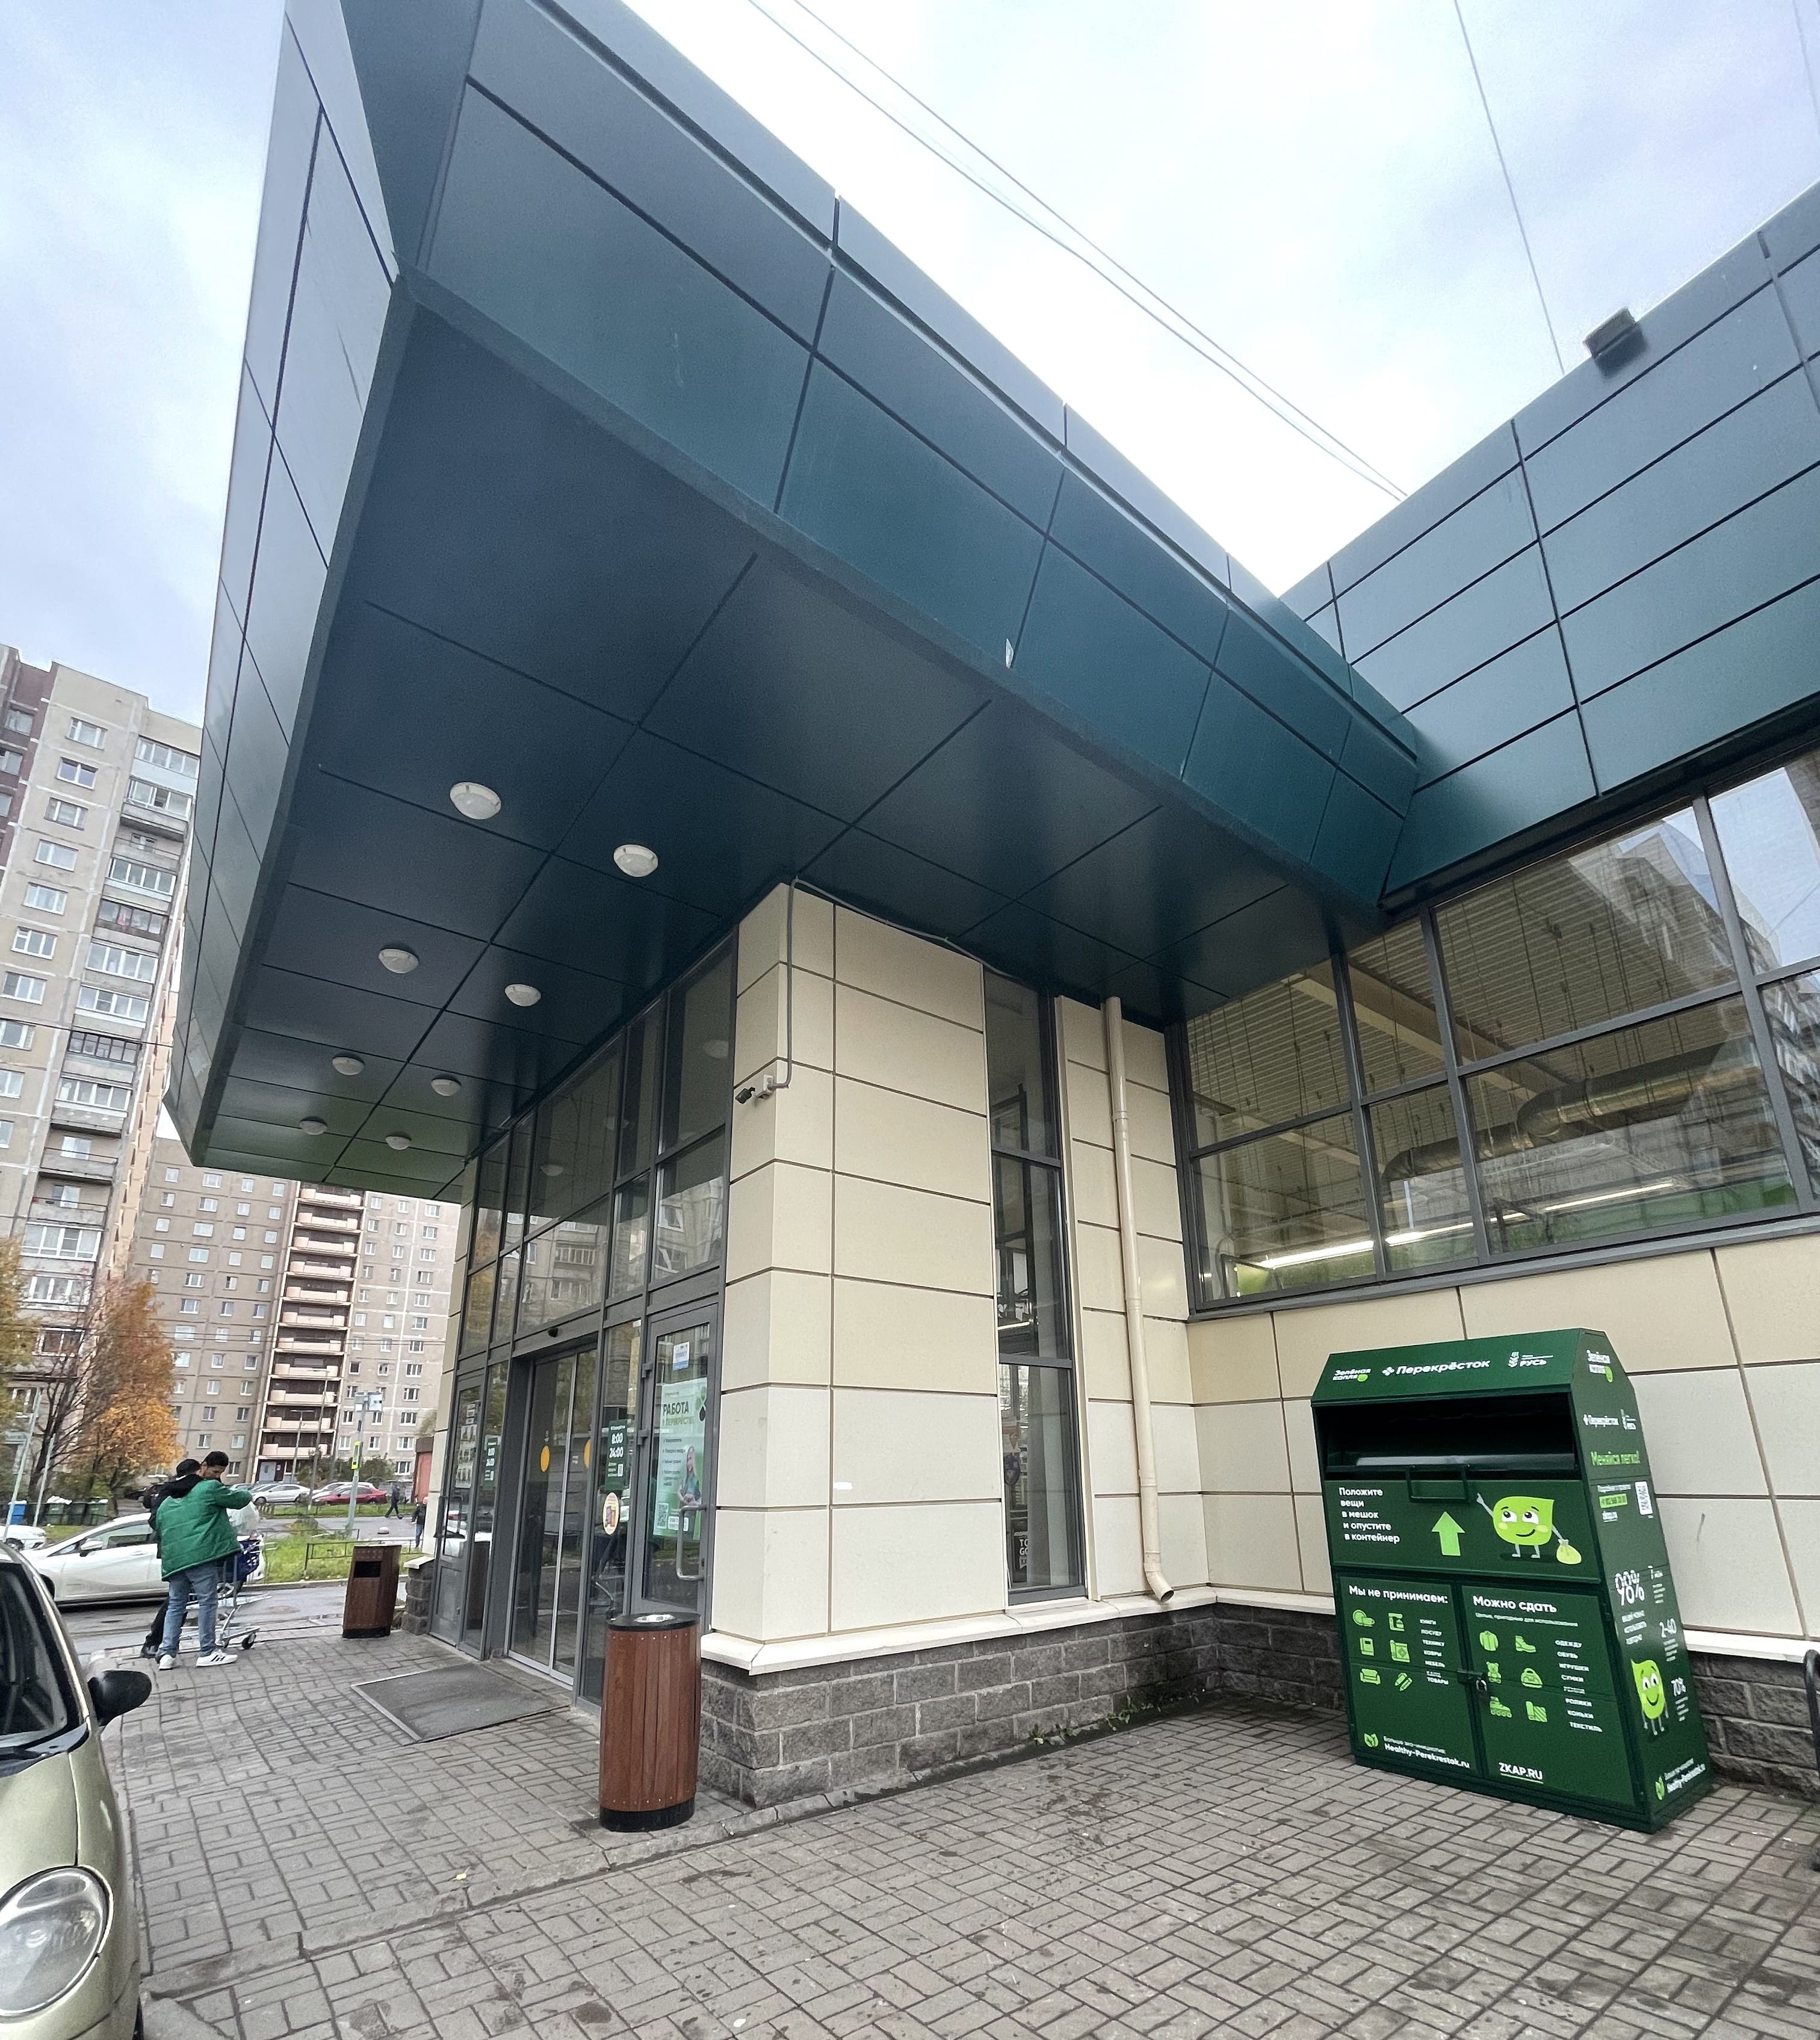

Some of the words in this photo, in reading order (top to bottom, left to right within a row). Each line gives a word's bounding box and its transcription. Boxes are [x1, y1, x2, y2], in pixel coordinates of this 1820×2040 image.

[1396, 1359, 1490, 1375] Перекрёсток
[611, 1432, 623, 1444] 8:00
[609, 1446, 624, 1458] 24:00
[1339, 1487, 1383, 1496] Положите
[1340, 1500, 1364, 1508] вещи
[1348, 1510, 1379, 1519] мешок
[1351, 1522, 1391, 1532] опустите
[1351, 1533, 1401, 1545] контейнер
[1349, 1585, 1366, 1596] Мы
[1367, 1589, 1381, 1598] не
[1383, 1590, 1449, 1604] принимаем:
[1473, 1595, 1516, 1610] Можно
[1518, 1601, 1557, 1613] сдать
[1384, 1743, 1470, 1769] Healthy-Perekrestok.ru
[1498, 1761, 1543, 1780] ZKAP.RU
